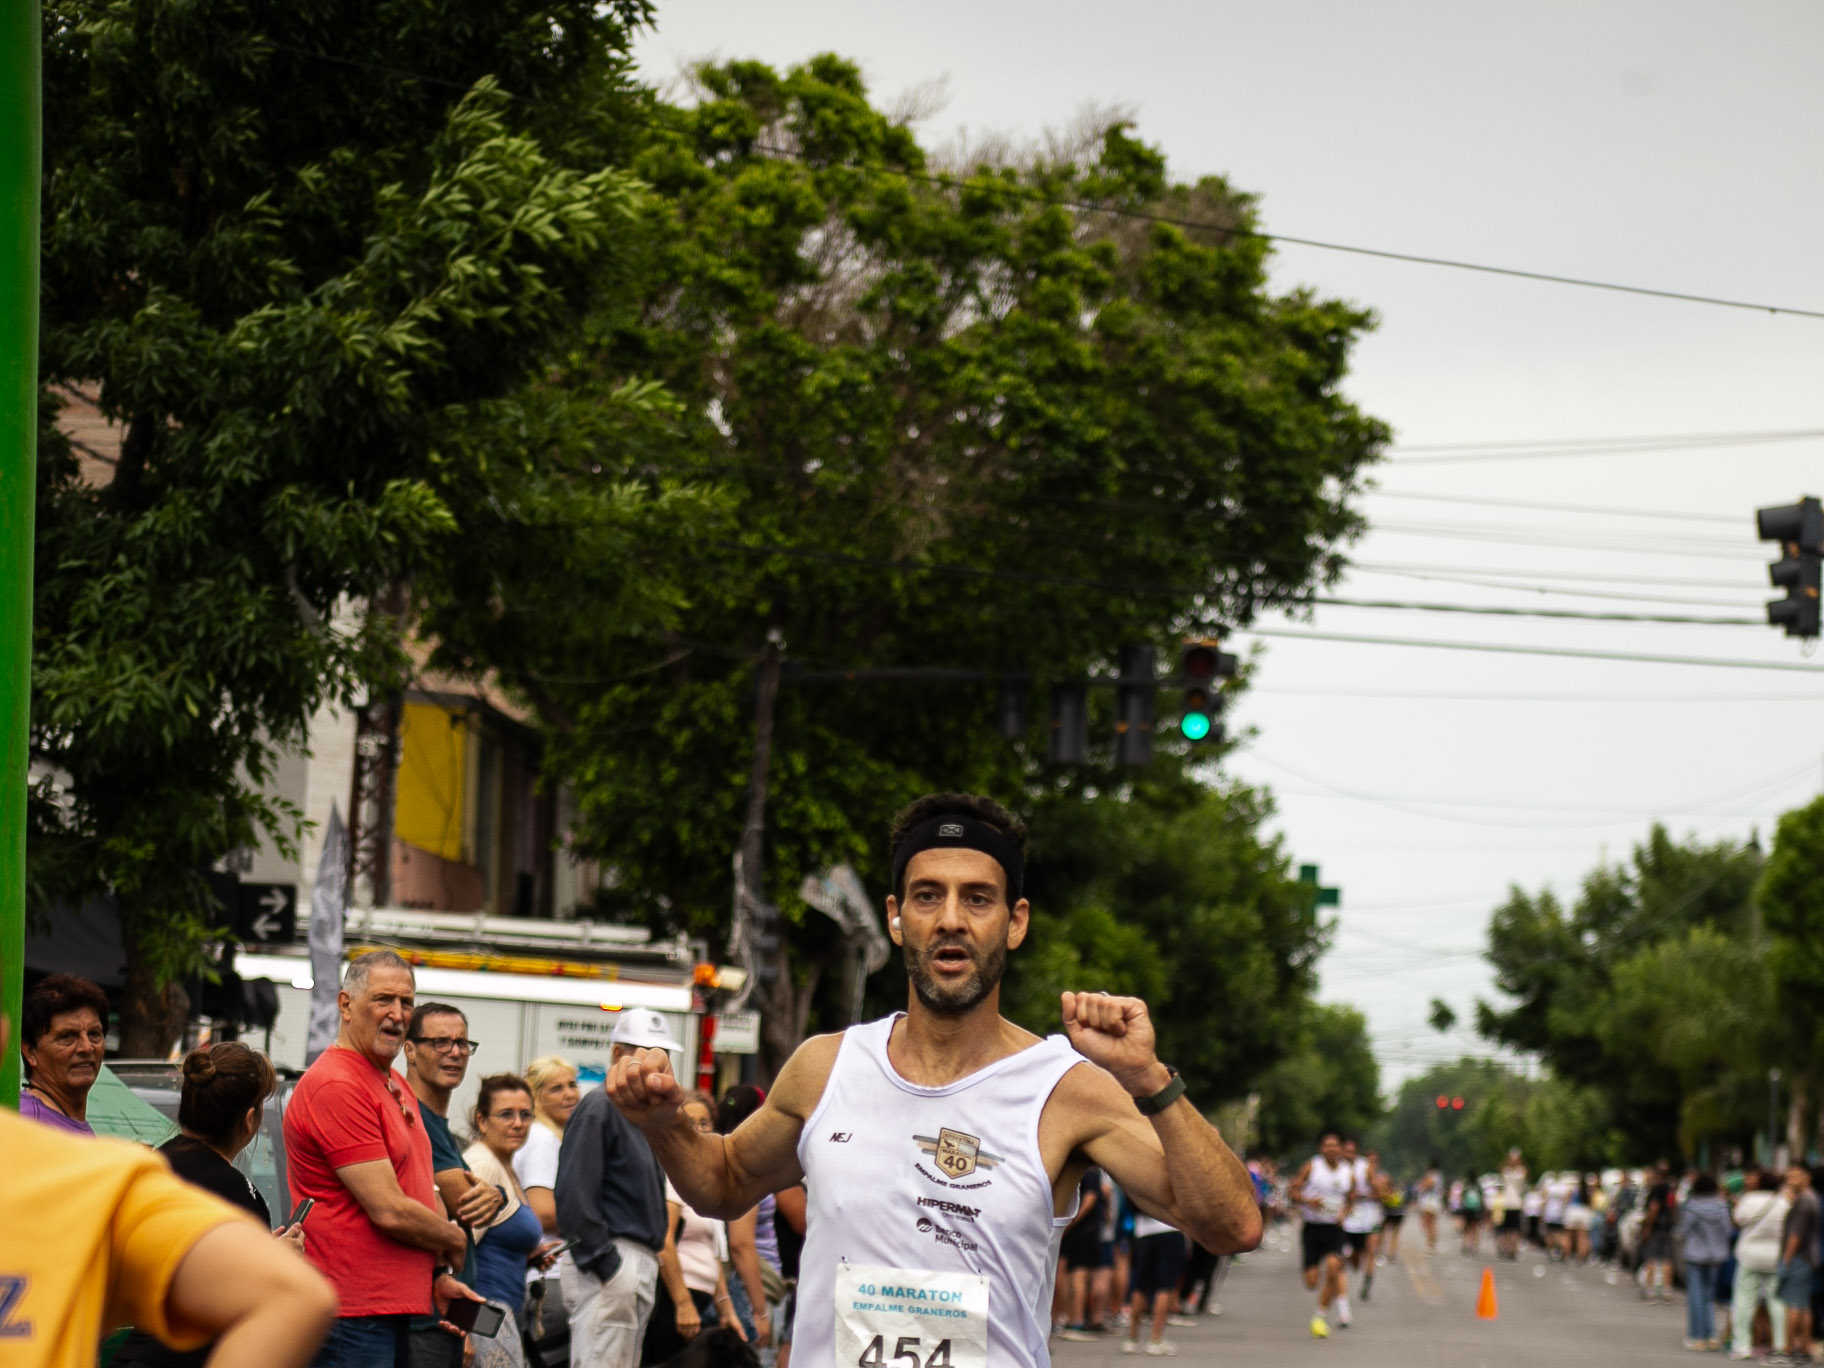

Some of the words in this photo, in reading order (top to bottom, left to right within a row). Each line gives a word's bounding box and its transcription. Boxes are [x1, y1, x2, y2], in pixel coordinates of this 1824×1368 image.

[943, 1155, 968, 1171] 40
[914, 1163, 948, 1187] EMPALME
[949, 1180, 992, 1190] GRANEROS
[935, 1224, 962, 1239] Banco
[935, 1234, 978, 1252] Municipal
[858, 1284, 876, 1296] 40
[881, 1286, 963, 1303] MARATON
[853, 1302, 905, 1313] EMPALME
[908, 1305, 968, 1319] GRANEROS
